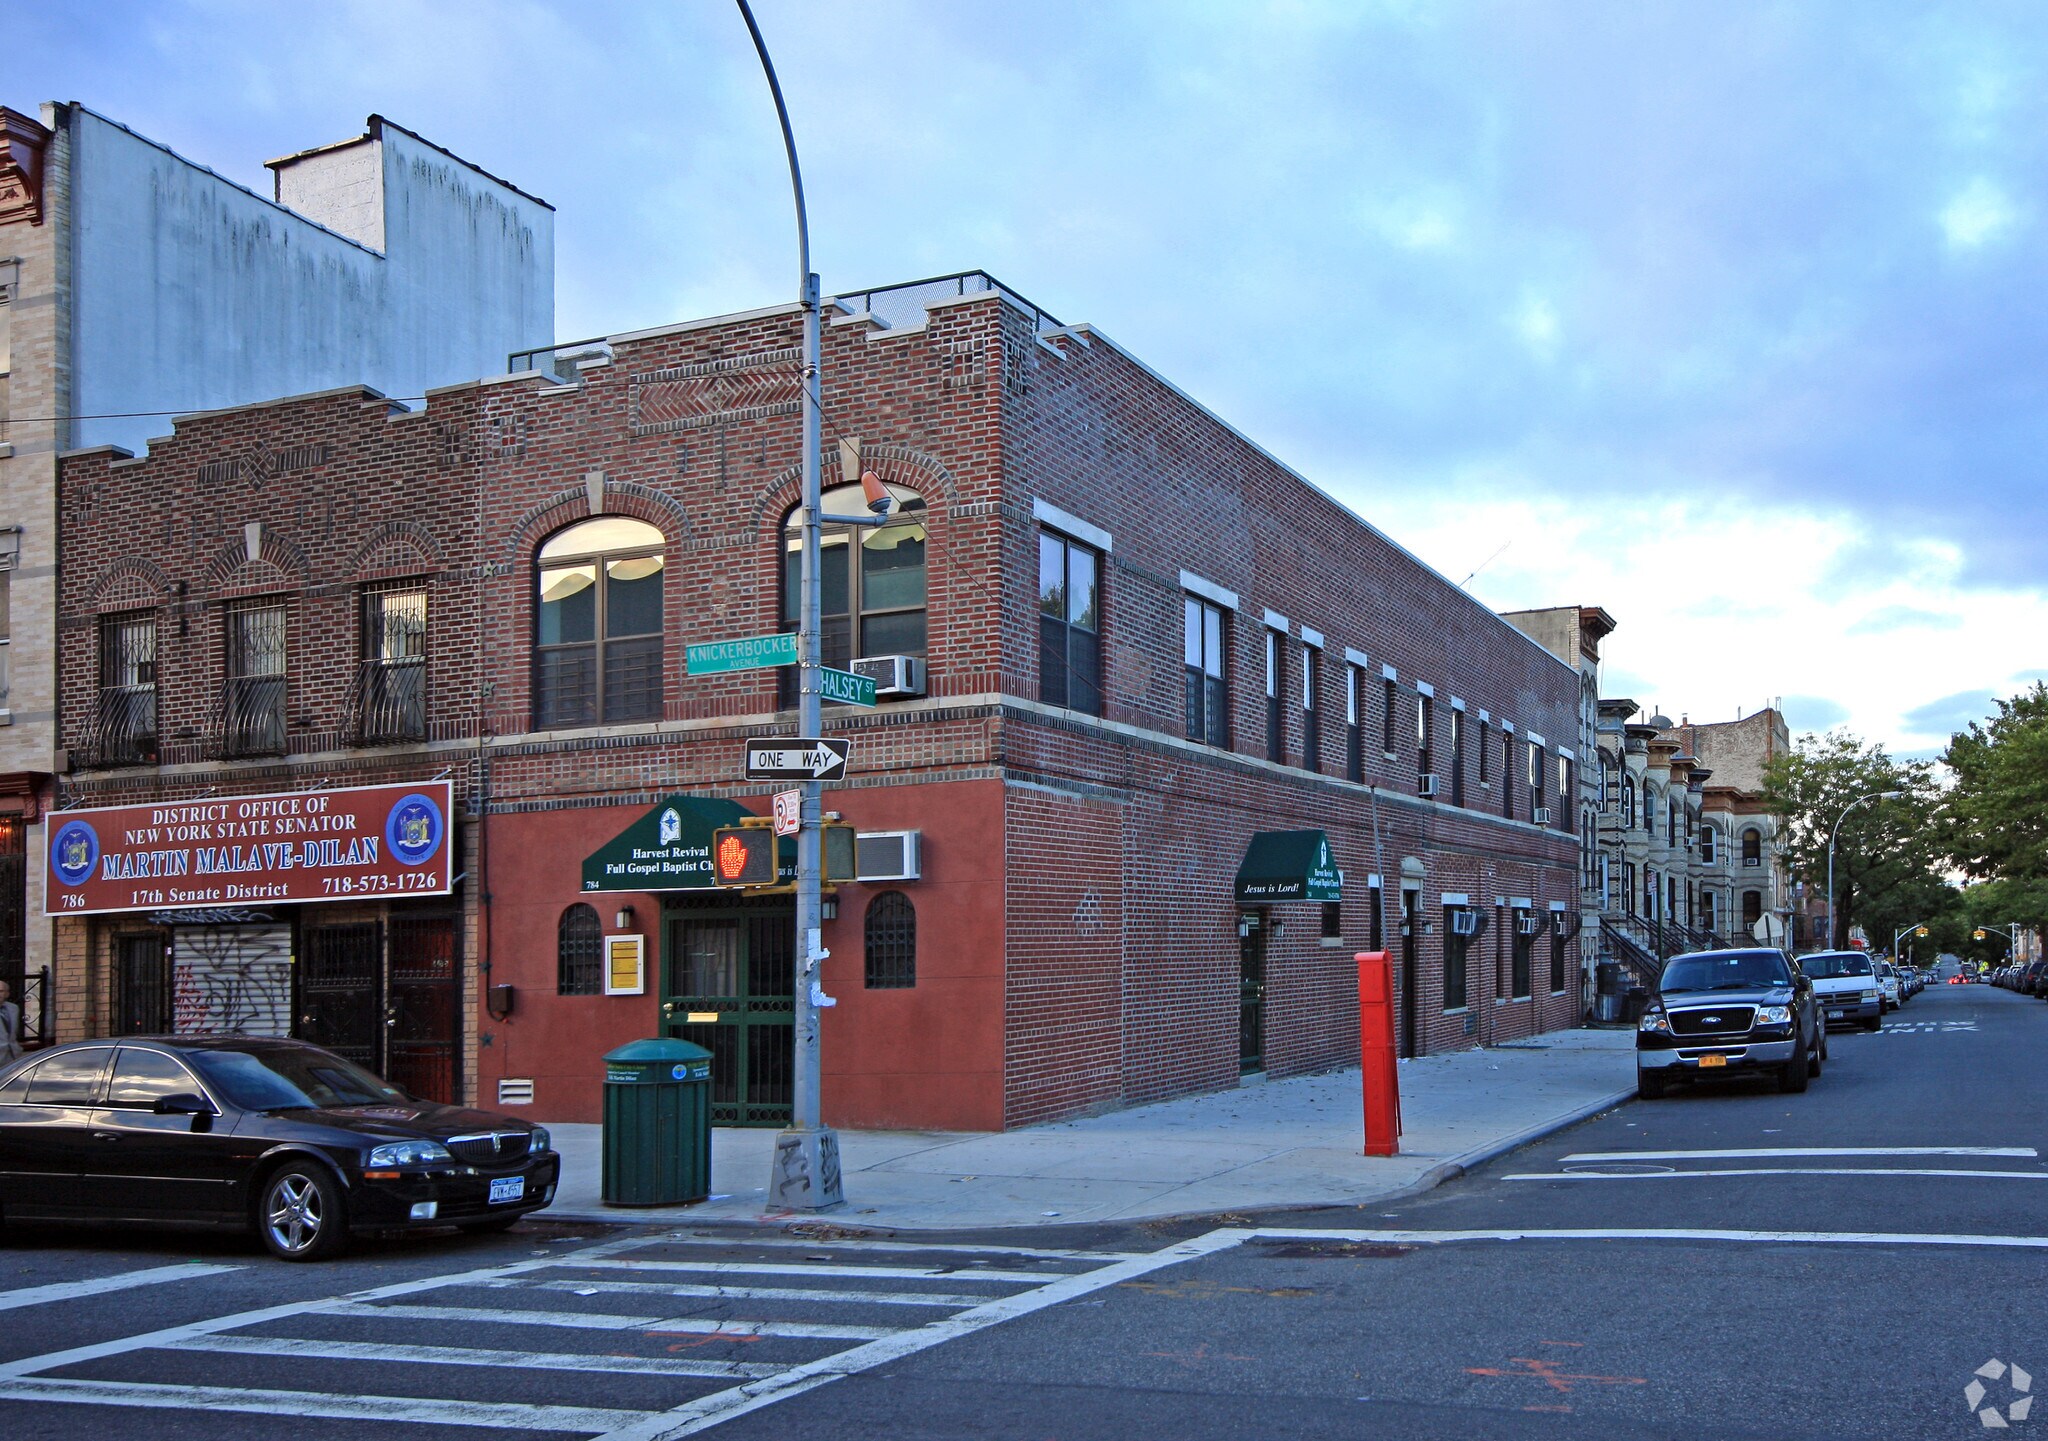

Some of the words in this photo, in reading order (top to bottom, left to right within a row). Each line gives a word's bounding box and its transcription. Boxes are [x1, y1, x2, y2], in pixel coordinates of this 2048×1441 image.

[690, 636, 797, 662] KNICKERBOCKER
[729, 657, 760, 668] AVENUE
[821, 670, 863, 701] HALSEY
[865, 681, 874, 693] ST
[758, 752, 784, 767] ONE
[802, 752, 833, 767] WAY
[152, 804, 229, 825] DISTRICT
[238, 799, 300, 819] OFFICE
[306, 796, 330, 813] OF
[125, 828, 161, 845] NEW
[166, 824, 212, 842] YORK
[217, 819, 270, 838] STATE
[275, 814, 356, 835] SENATOR
[102, 849, 189, 880] MARTIN
[195, 836, 380, 875] MALAVE-DILAN
[632, 848, 670, 859] Harvest
[673, 846, 709, 858] Revival
[606, 863, 625, 874] Full
[627, 862, 660, 876] Gospel
[662, 862, 697, 875] Baptist
[322, 871, 437, 894] 718-573-1726
[586, 881, 599, 889] 784
[1244, 884, 1266, 894] Jesus
[1268, 884, 1275, 893] is
[1278, 883, 1299, 893] Lord!
[61, 893, 85, 908] 786
[132, 889, 163, 904] 17th
[169, 887, 220, 902] Senate
[226, 882, 289, 899] District
